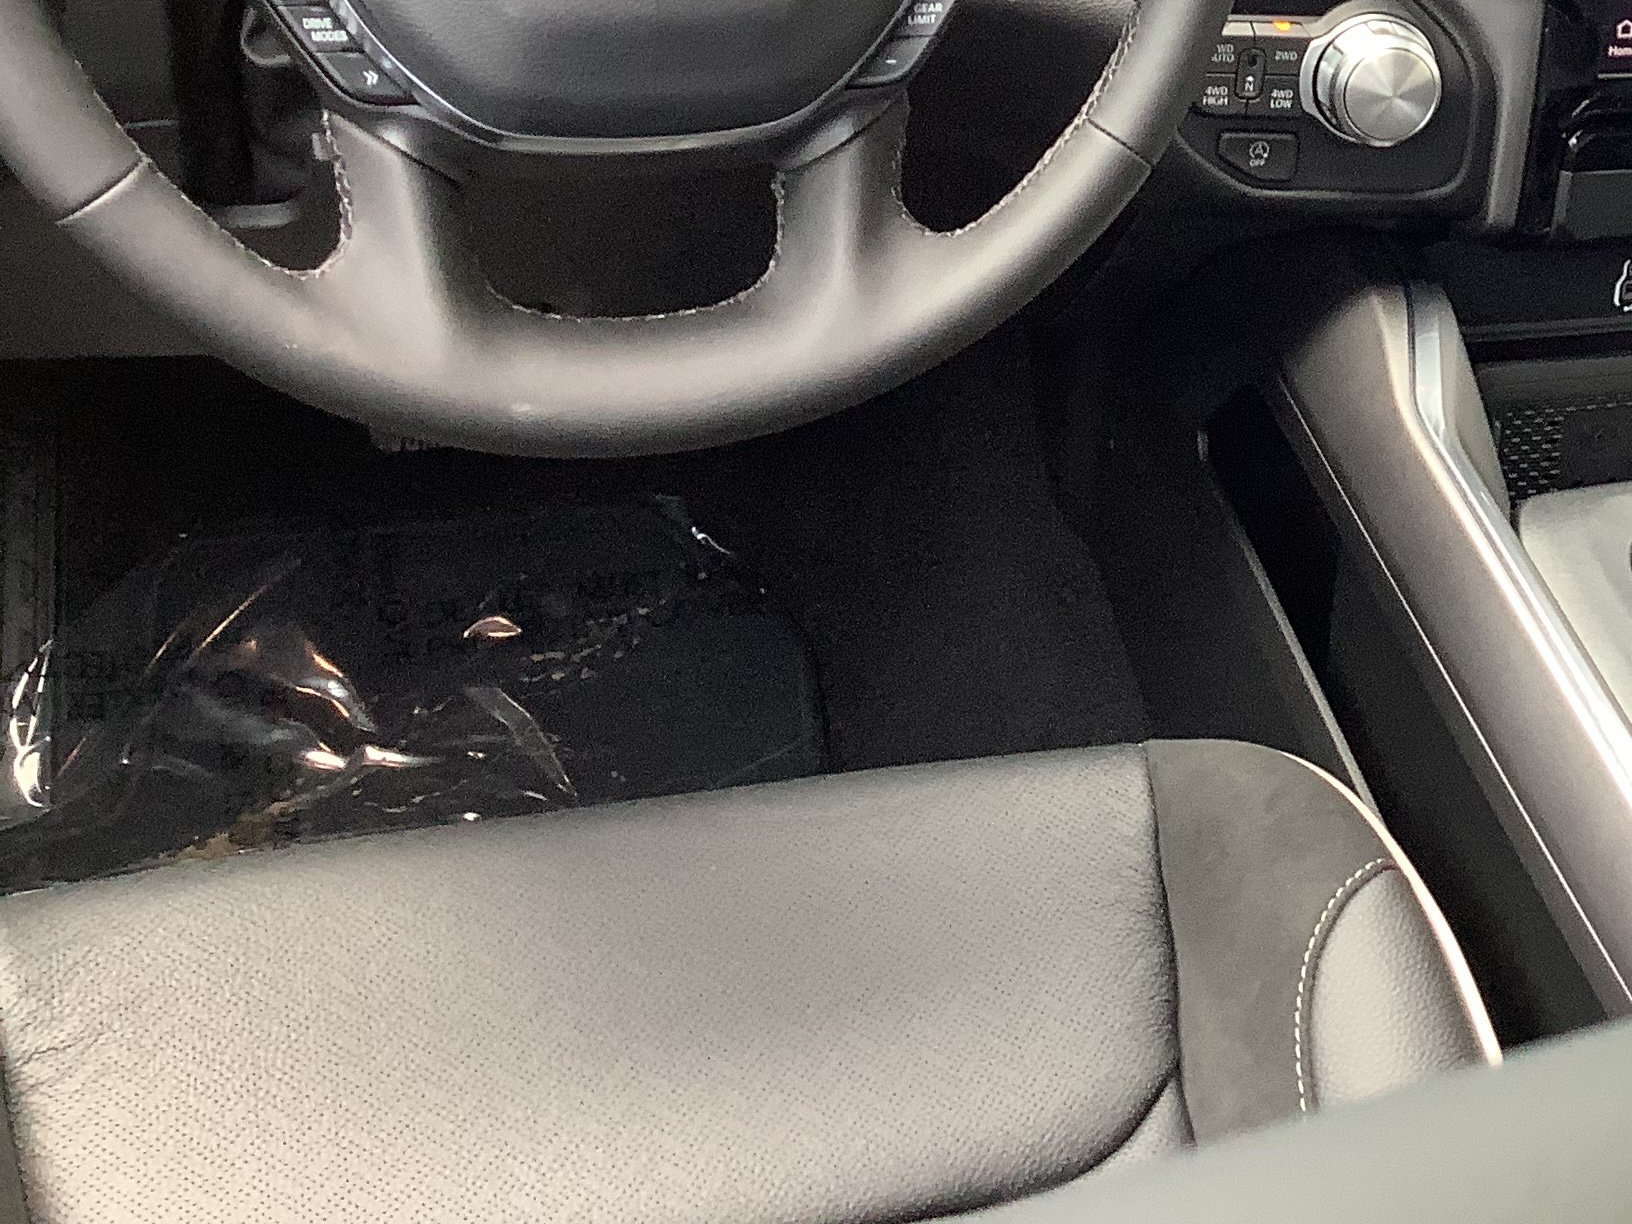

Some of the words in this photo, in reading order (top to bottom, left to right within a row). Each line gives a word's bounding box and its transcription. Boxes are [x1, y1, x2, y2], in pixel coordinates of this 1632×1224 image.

[913, 2, 944, 14] GEAR
[302, 17, 333, 30] DRIVE
[907, 13, 937, 26] LIMIT
[311, 29, 349, 42] MODES
[1274, 50, 1298, 61] 2WD
[1204, 85, 1229, 96] 4WD
[1244, 82, 1254, 92] N
[1270, 88, 1294, 99] 4WD
[1202, 95, 1229, 107] HIGH
[1269, 98, 1293, 109] LOW
